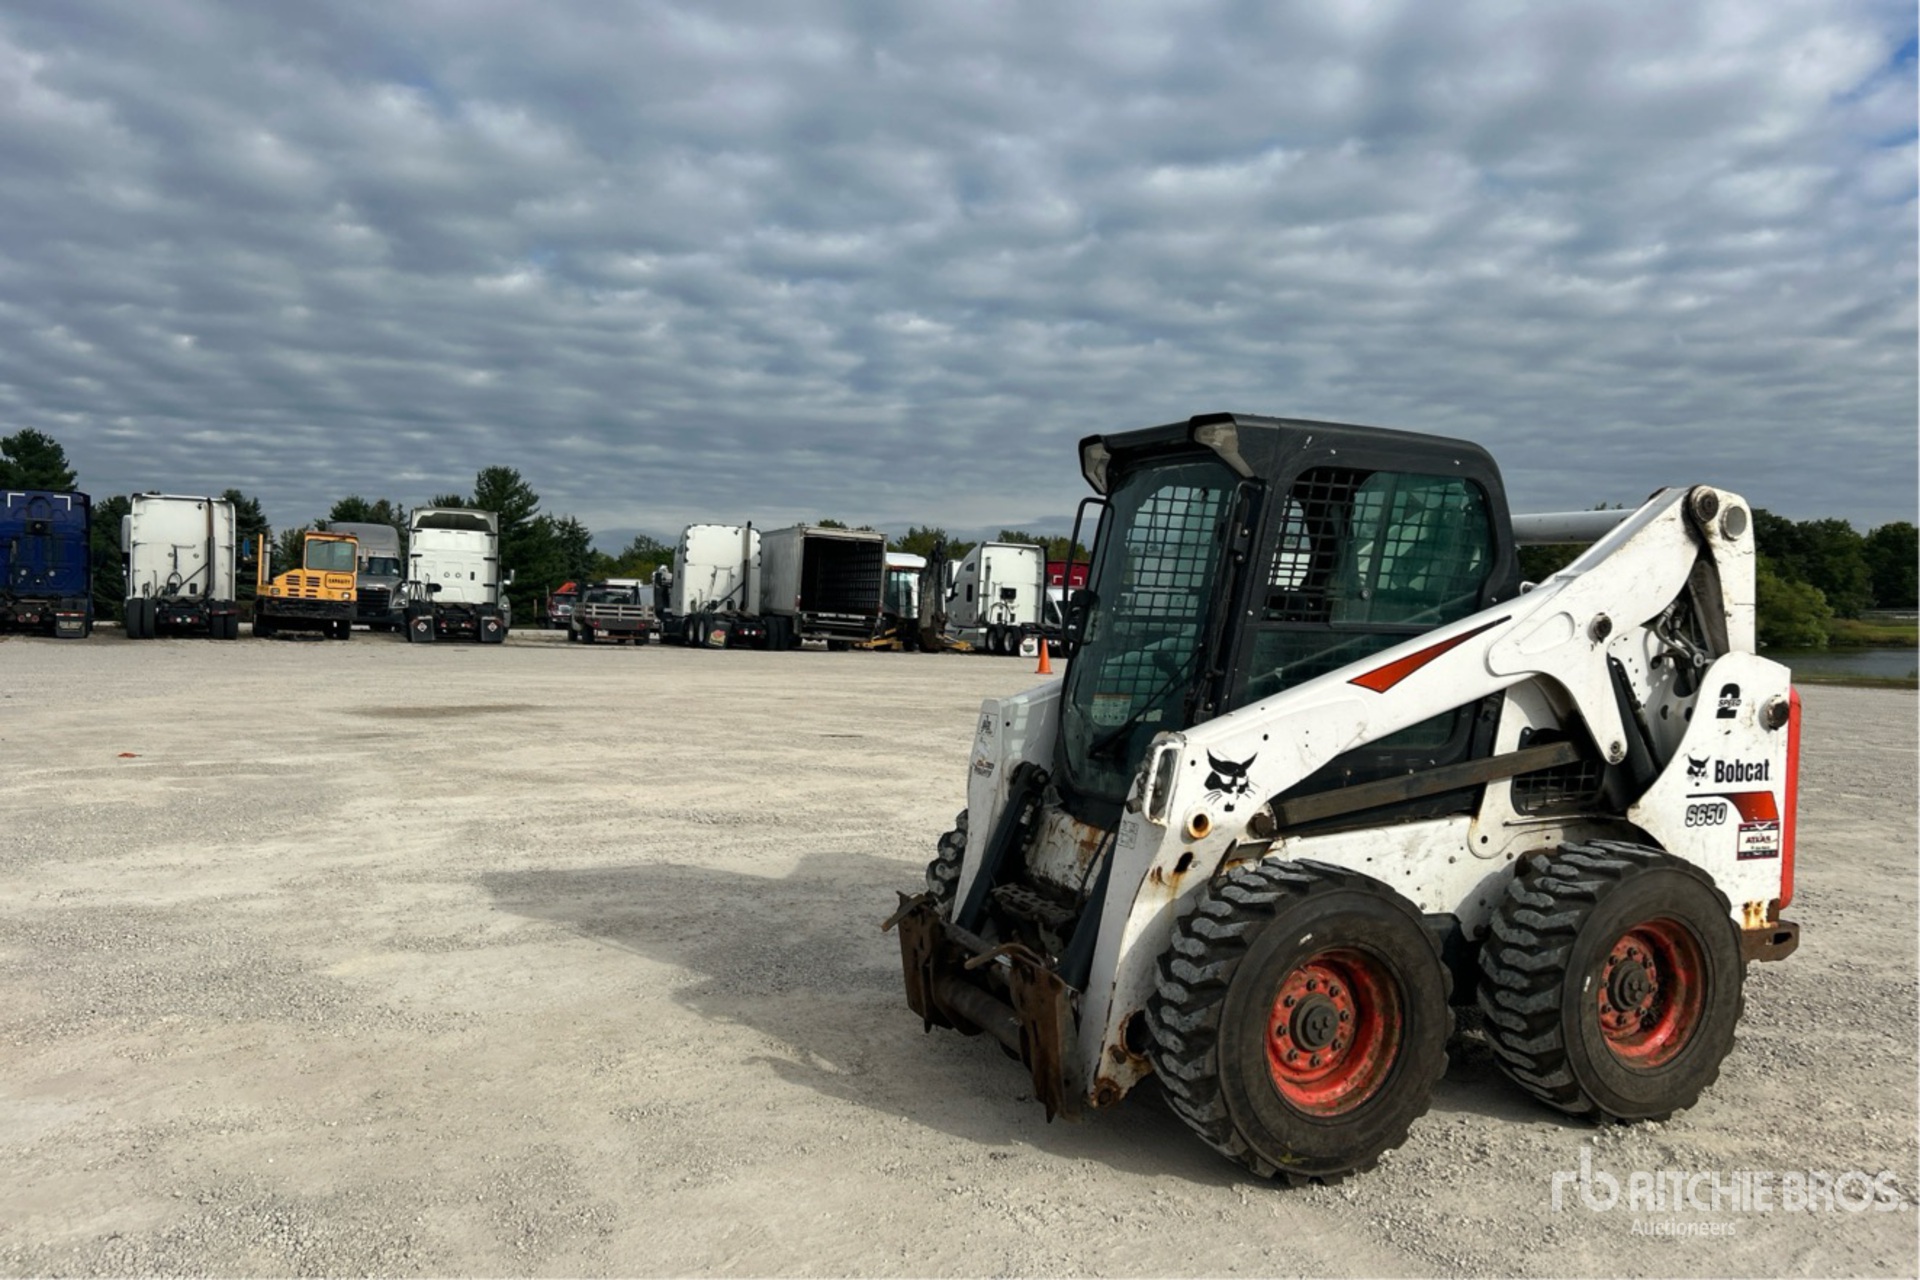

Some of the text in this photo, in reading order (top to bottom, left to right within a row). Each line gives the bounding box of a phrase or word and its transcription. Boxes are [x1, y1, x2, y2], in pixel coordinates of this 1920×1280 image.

[1715, 683, 1741, 719] 2
[1718, 699, 1742, 707] SPEED
[1714, 759, 1769, 783] Bobcat
[1685, 802, 1728, 827] S650
